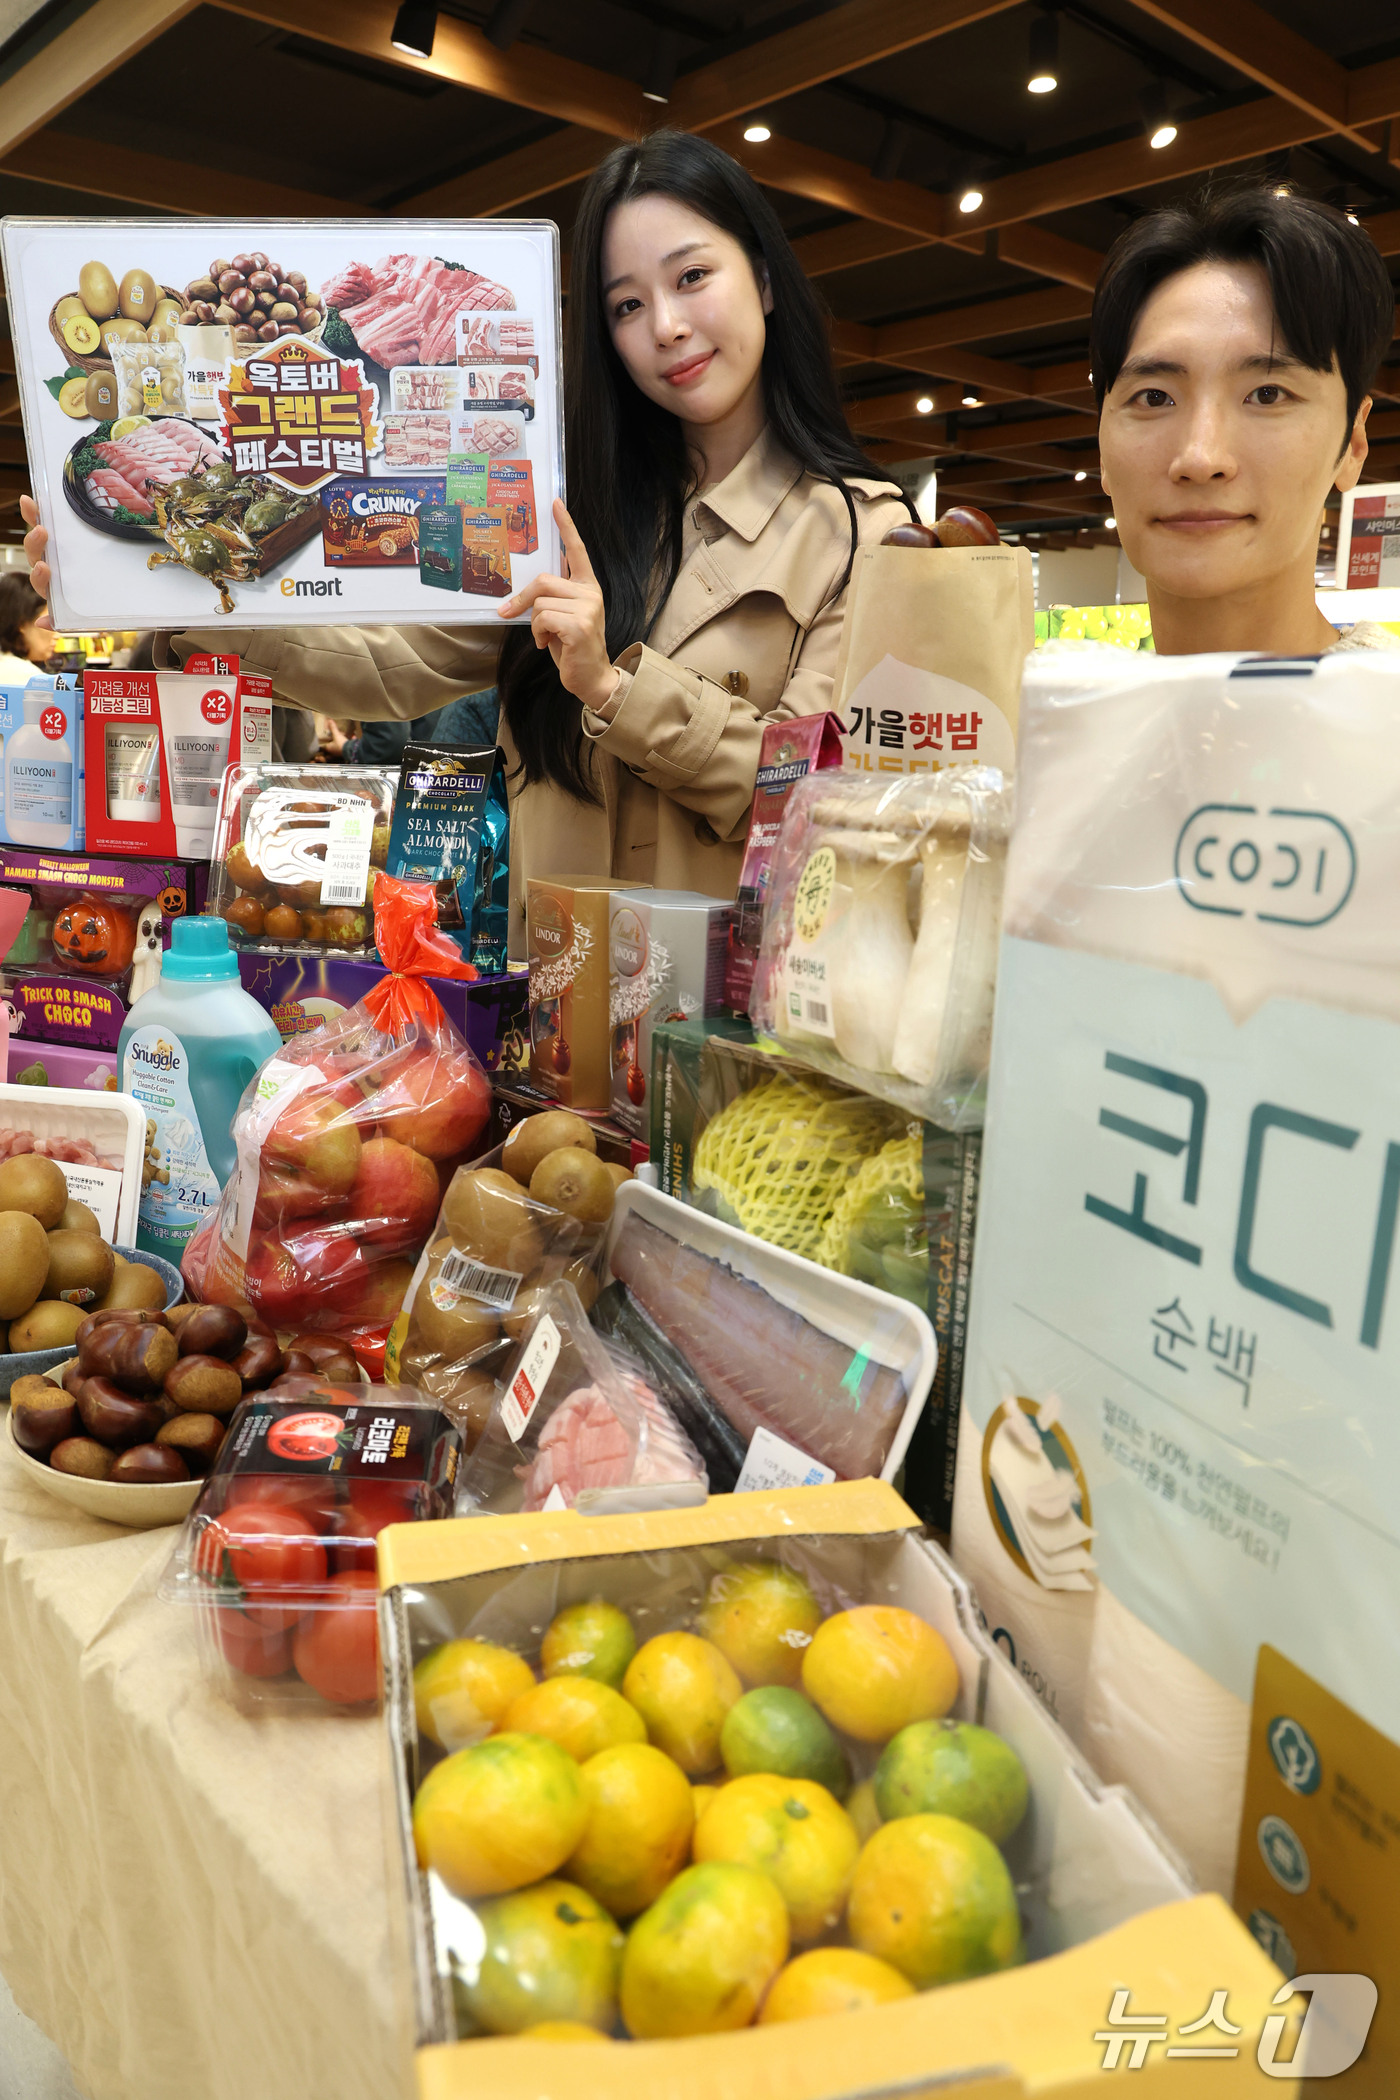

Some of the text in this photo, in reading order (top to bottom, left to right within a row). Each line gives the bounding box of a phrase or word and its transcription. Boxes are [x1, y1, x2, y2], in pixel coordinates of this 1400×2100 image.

[248, 362, 339, 393] 옥토버
[231, 394, 363, 437] 그랜드
[233, 439, 365, 474] 페스티벌
[351, 492, 422, 516] CRUNKY
[1351, 552, 1380, 564] 신세계
[1350, 564, 1378, 576] 포인트
[280, 577, 343, 597] emart
[91, 680, 150, 698] 가려움 개선
[92, 698, 150, 714] 기능성 크림
[108, 739, 147, 749] ILLIYOON
[174, 742, 215, 752] ILLIYOON
[13, 766, 52, 778] ILLIYOON
[408, 775, 481, 789] GHIRARDELLI
[756, 764, 806, 785] GHIRARDELLI
[406, 801, 475, 812] PEMIUM DARK
[407, 818, 468, 833] SEA SALT
[406, 833, 461, 850] ALMOND
[332, 861, 361, 869] 사과대추
[1194, 835, 1327, 896] CODI
[4, 866, 125, 888] HAMMER SMASH CHOCO MONSTER
[535, 927, 561, 945] LINDOR
[614, 947, 638, 965] LINDOR
[21, 985, 112, 1014] TRICK OR SMASH
[44, 1003, 93, 1027] CHOCO
[131, 1042, 181, 1071] Snuggle
[133, 1069, 175, 1085] Huggable Cotton
[672, 1141, 683, 1201] SHINE
[1084, 1049, 1400, 1352] 코디
[936, 1234, 956, 1335] MUSCAT
[1149, 1296, 1259, 1408] 순백
[360, 1417, 396, 1465] 리코마토
